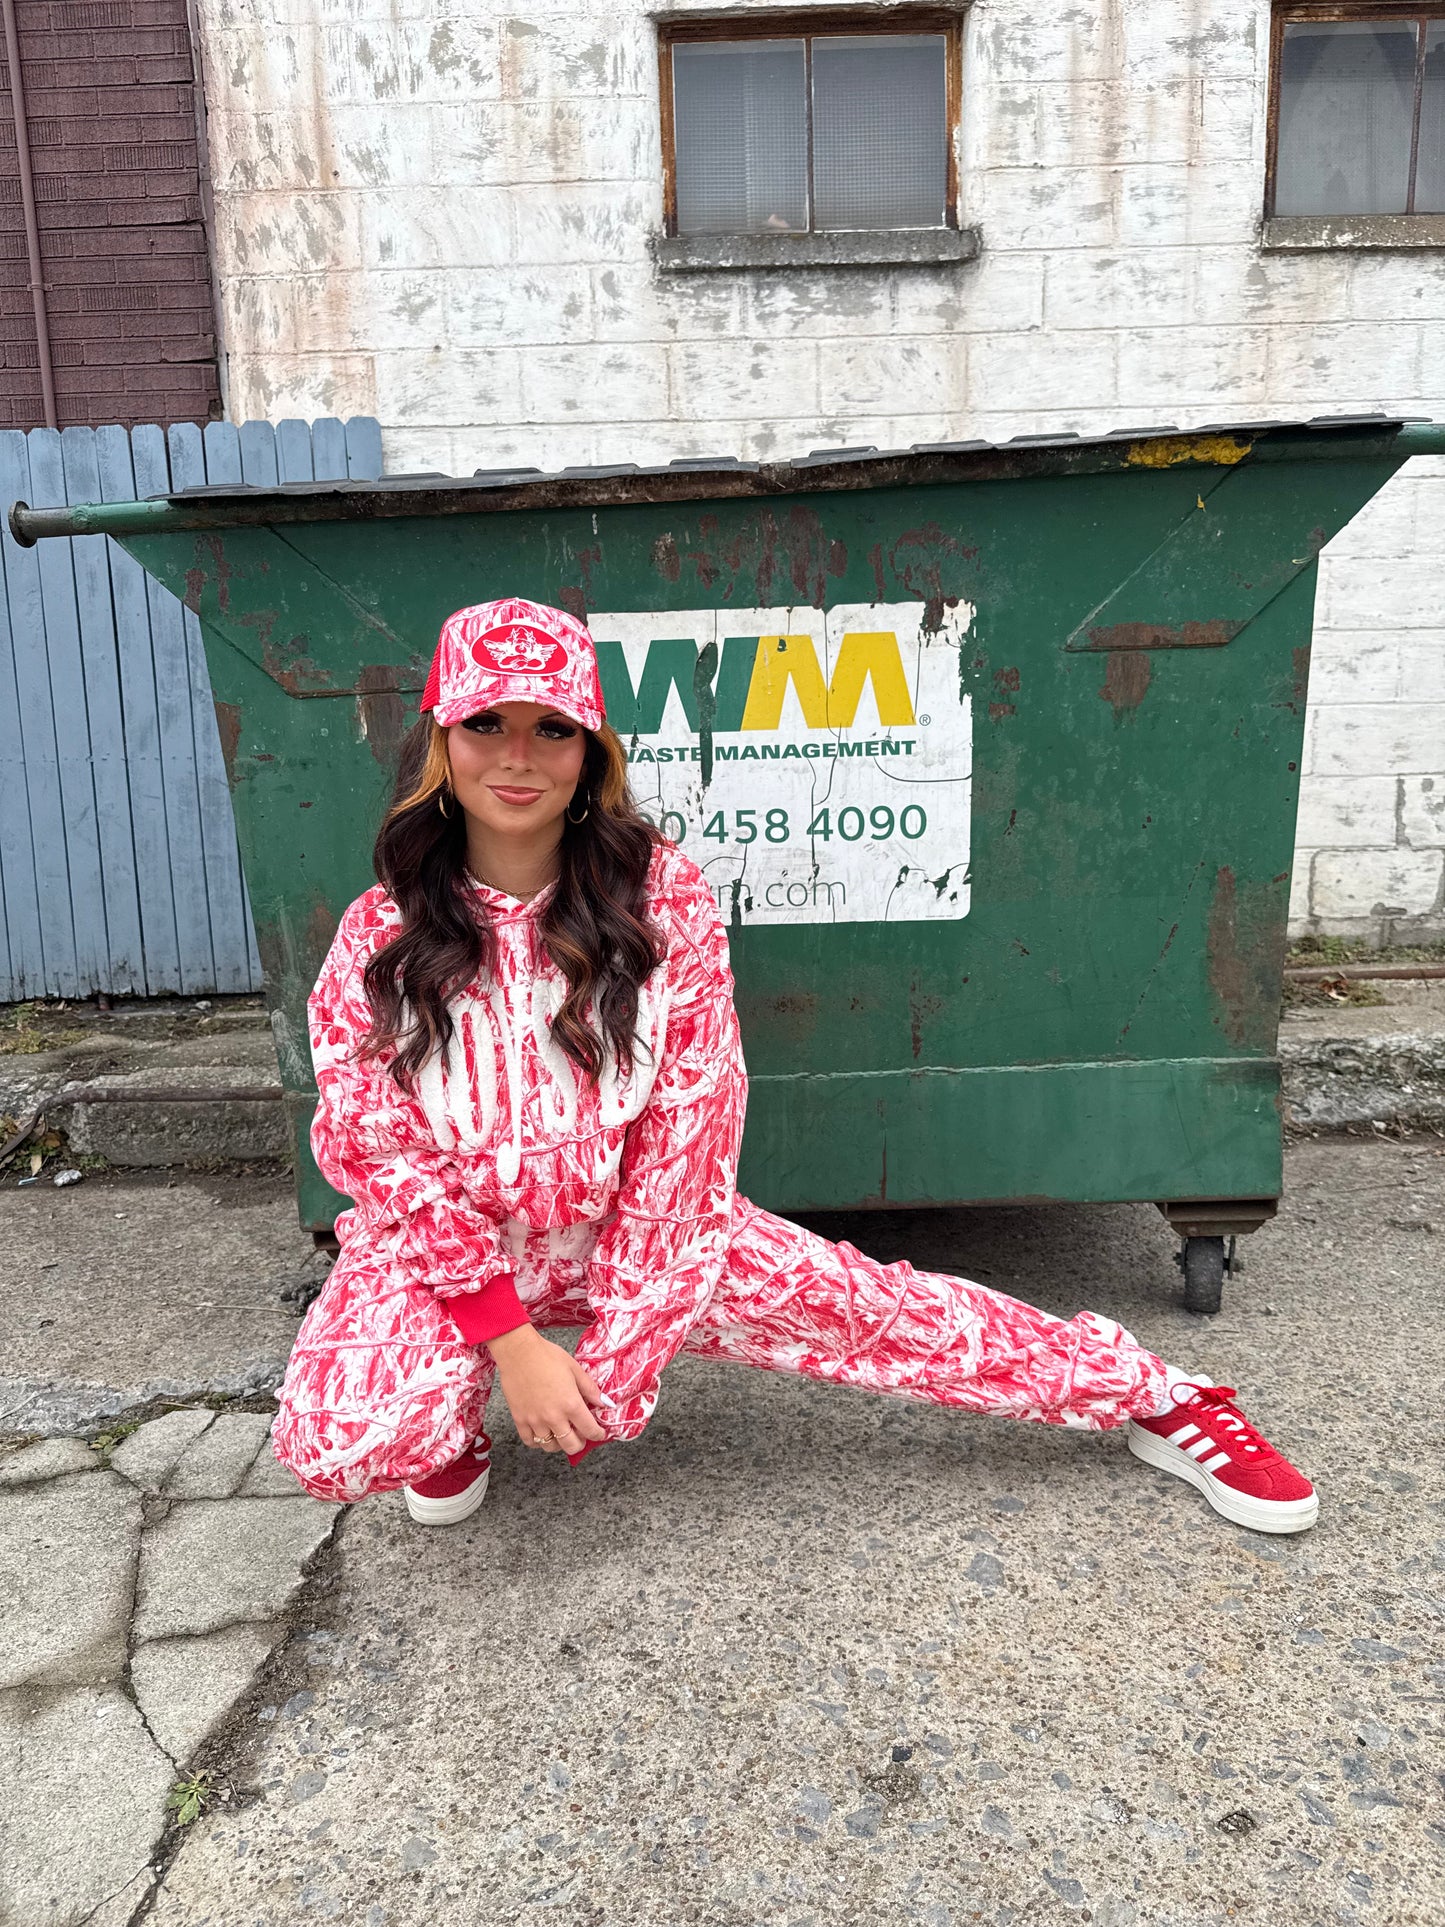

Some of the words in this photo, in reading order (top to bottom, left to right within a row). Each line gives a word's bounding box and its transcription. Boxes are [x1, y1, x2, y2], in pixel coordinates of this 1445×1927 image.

[715, 740, 917, 761] MANAGEMENT
[702, 808, 790, 844] 458
[806, 804, 928, 842] 4090
[710, 881, 847, 908] m.com
